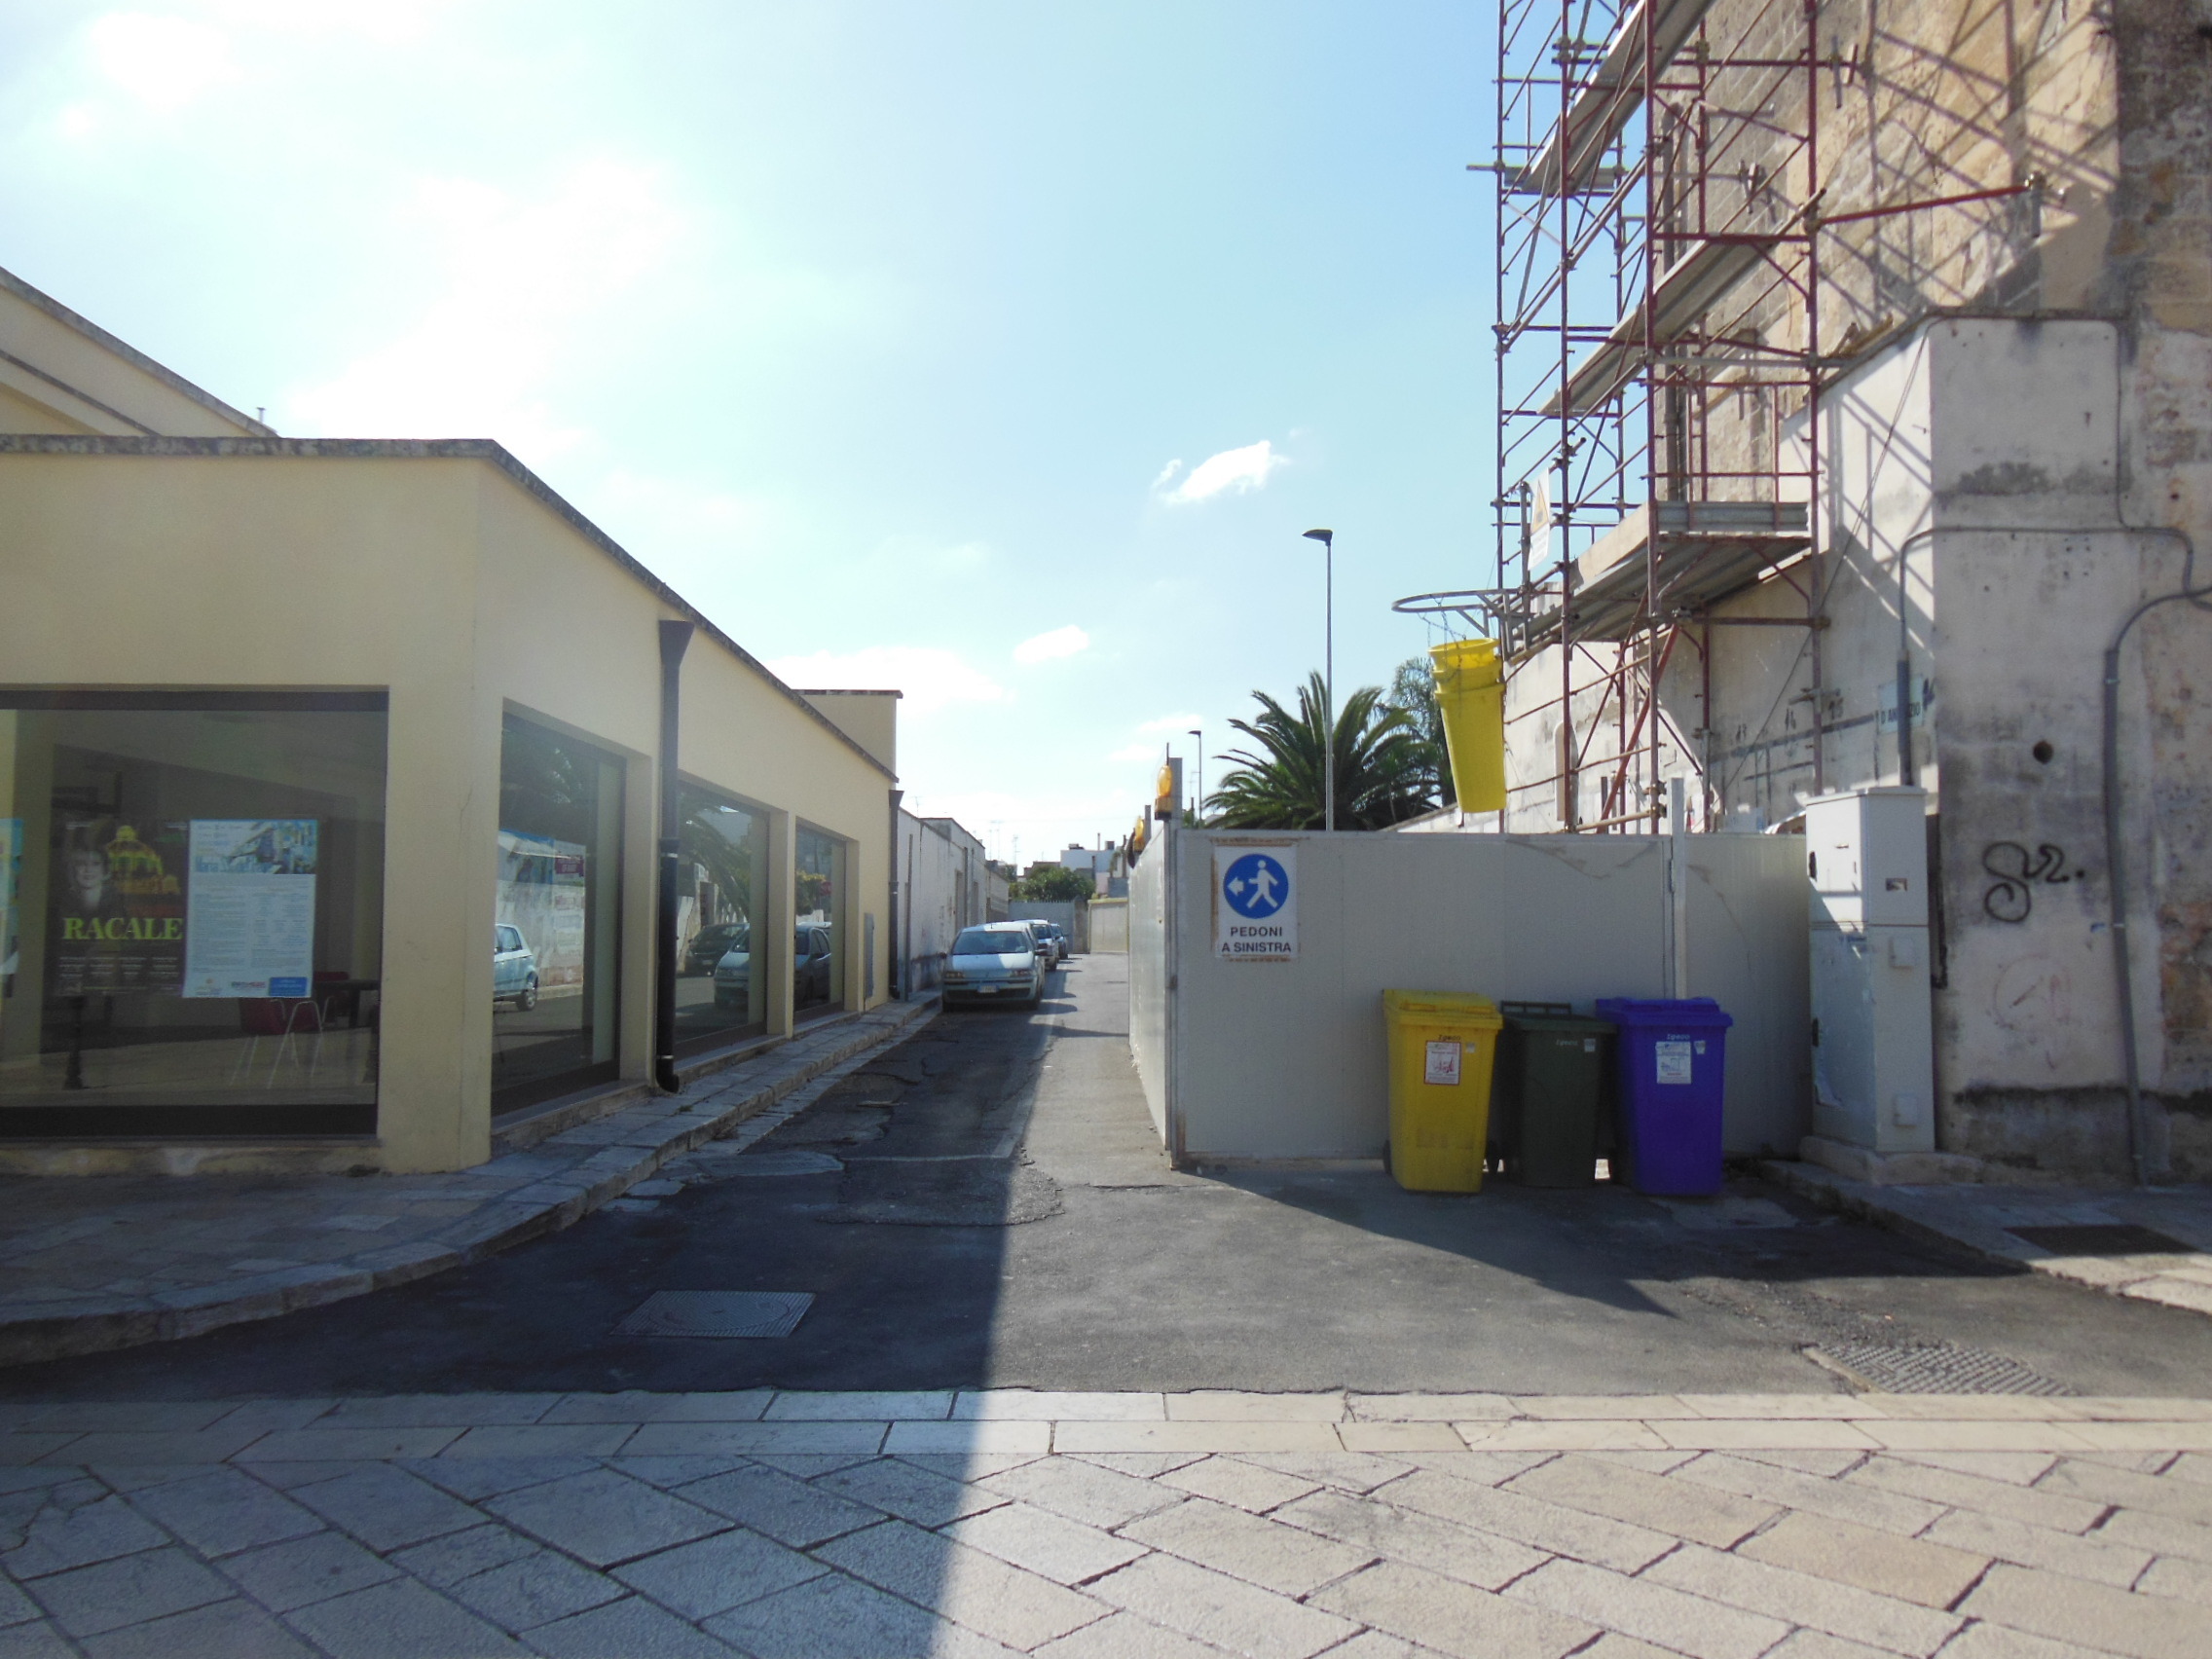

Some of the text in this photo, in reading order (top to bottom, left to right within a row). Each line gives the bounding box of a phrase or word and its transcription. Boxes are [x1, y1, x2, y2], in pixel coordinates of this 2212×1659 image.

[62, 917, 184, 940] RACALE
[1230, 926, 1283, 938] PEDONI
[1221, 941, 1292, 953] A SINISTRA
